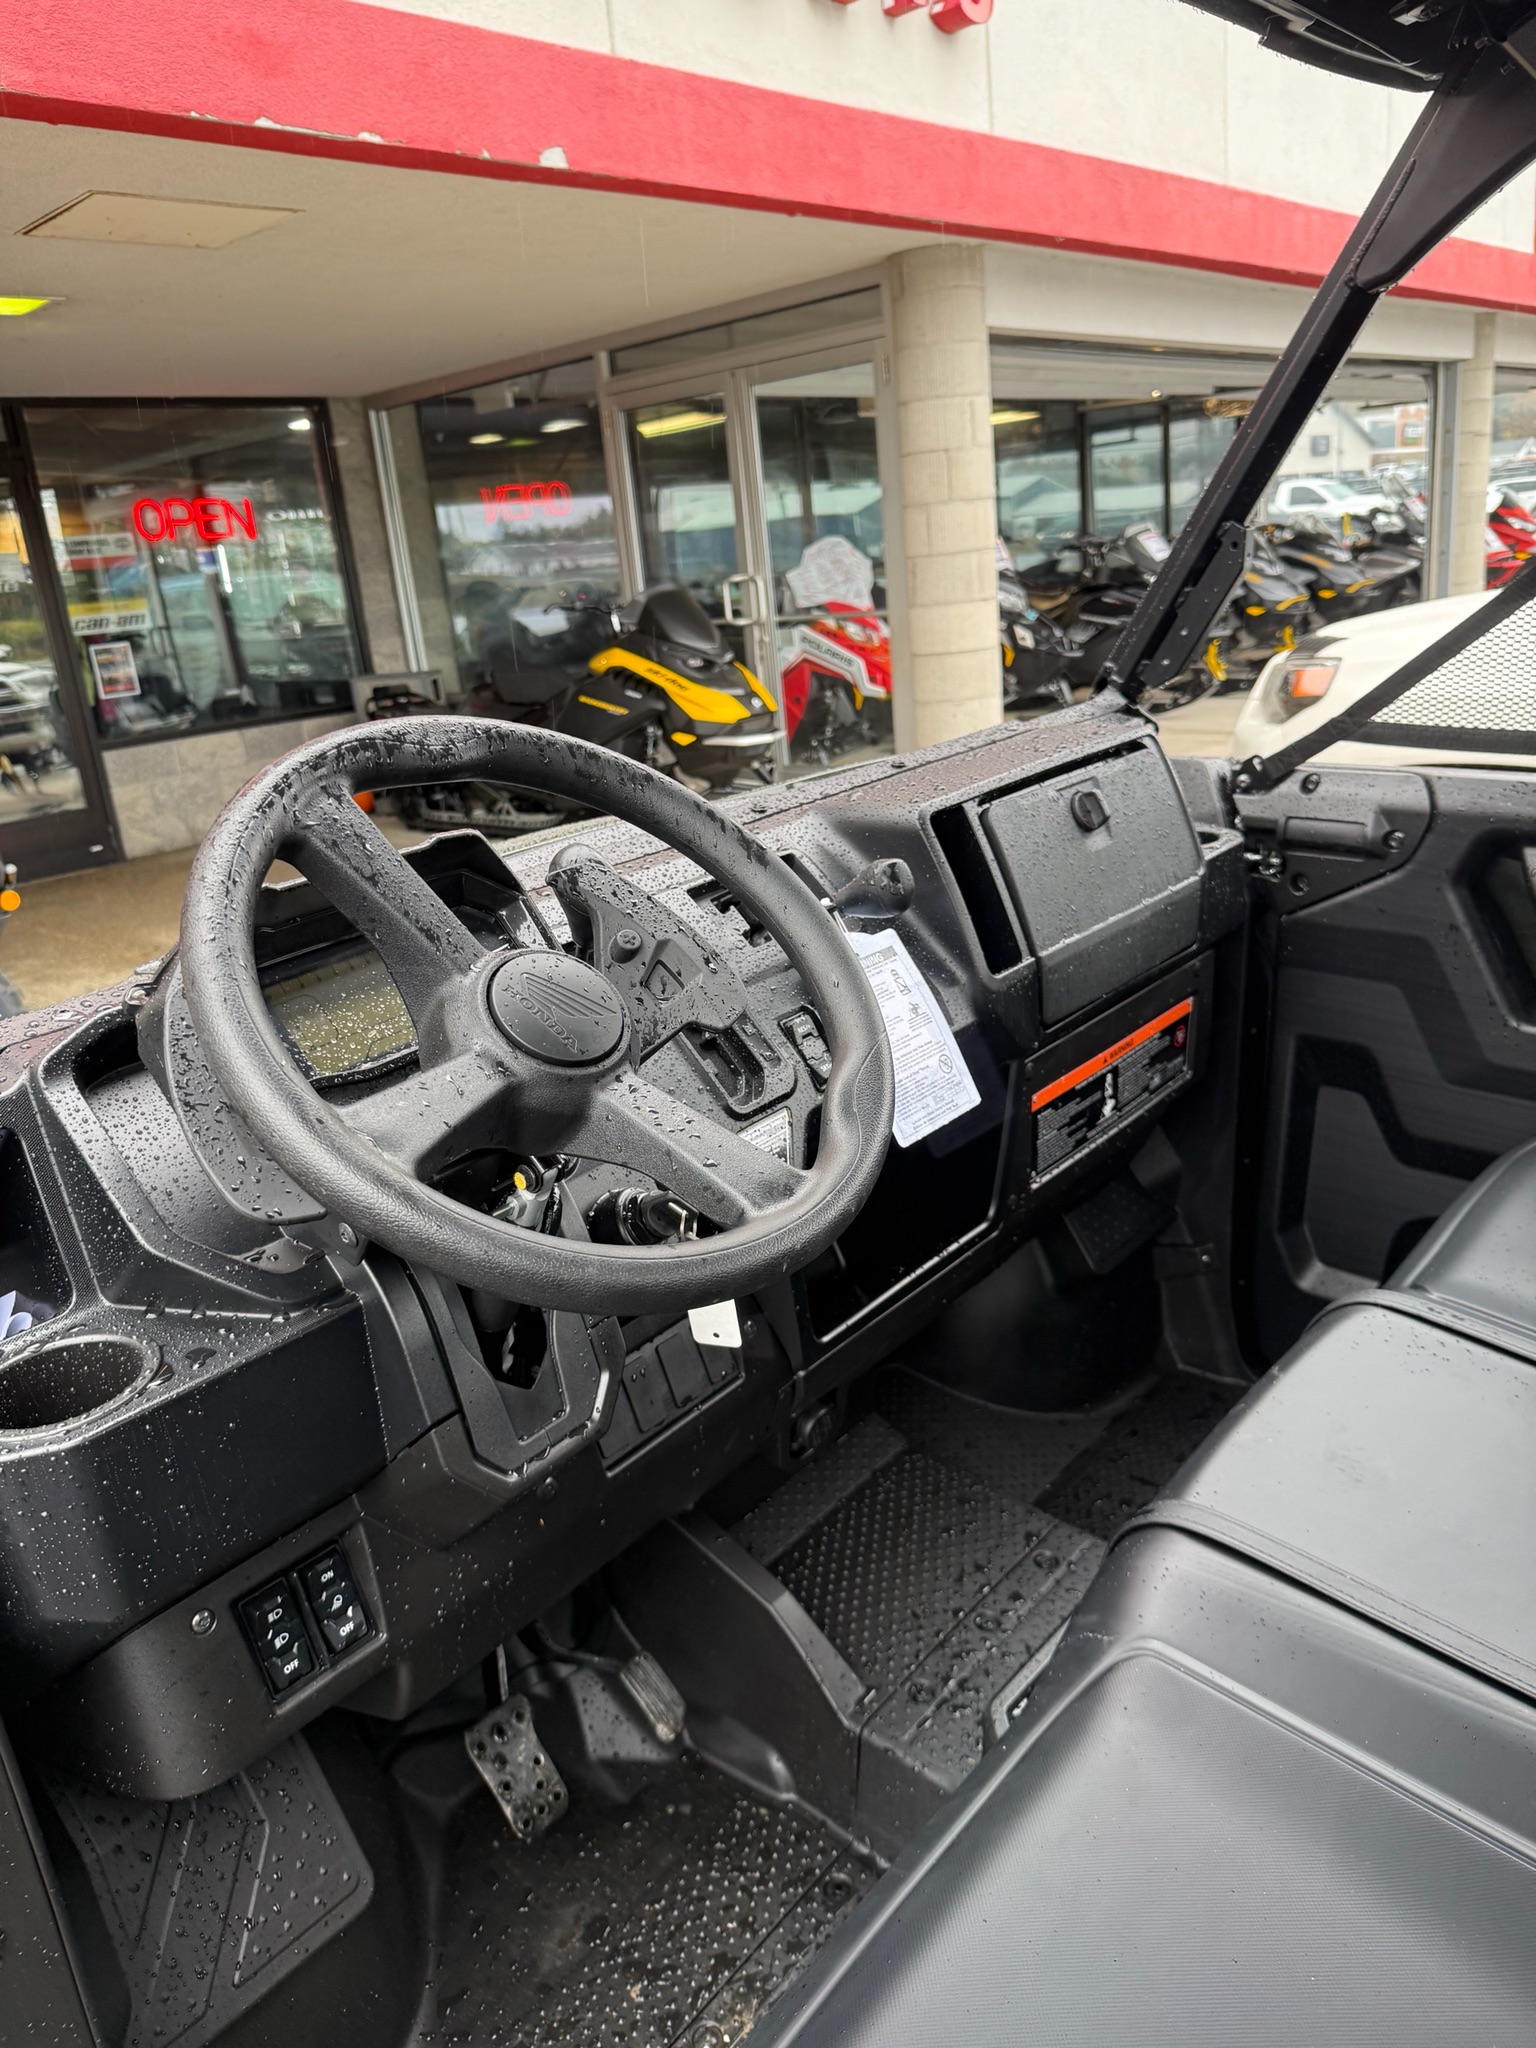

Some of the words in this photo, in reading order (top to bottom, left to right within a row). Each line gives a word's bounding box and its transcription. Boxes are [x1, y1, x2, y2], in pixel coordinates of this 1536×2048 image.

[132, 497, 258, 541] OPEN
[74, 614, 147, 632] can-am
[501, 983, 578, 1054] HONDA
[1108, 1037, 1134, 1059] WARNING
[321, 1569, 334, 1583] ON
[339, 1620, 355, 1636] OFF
[284, 1658, 300, 1675] OFF
